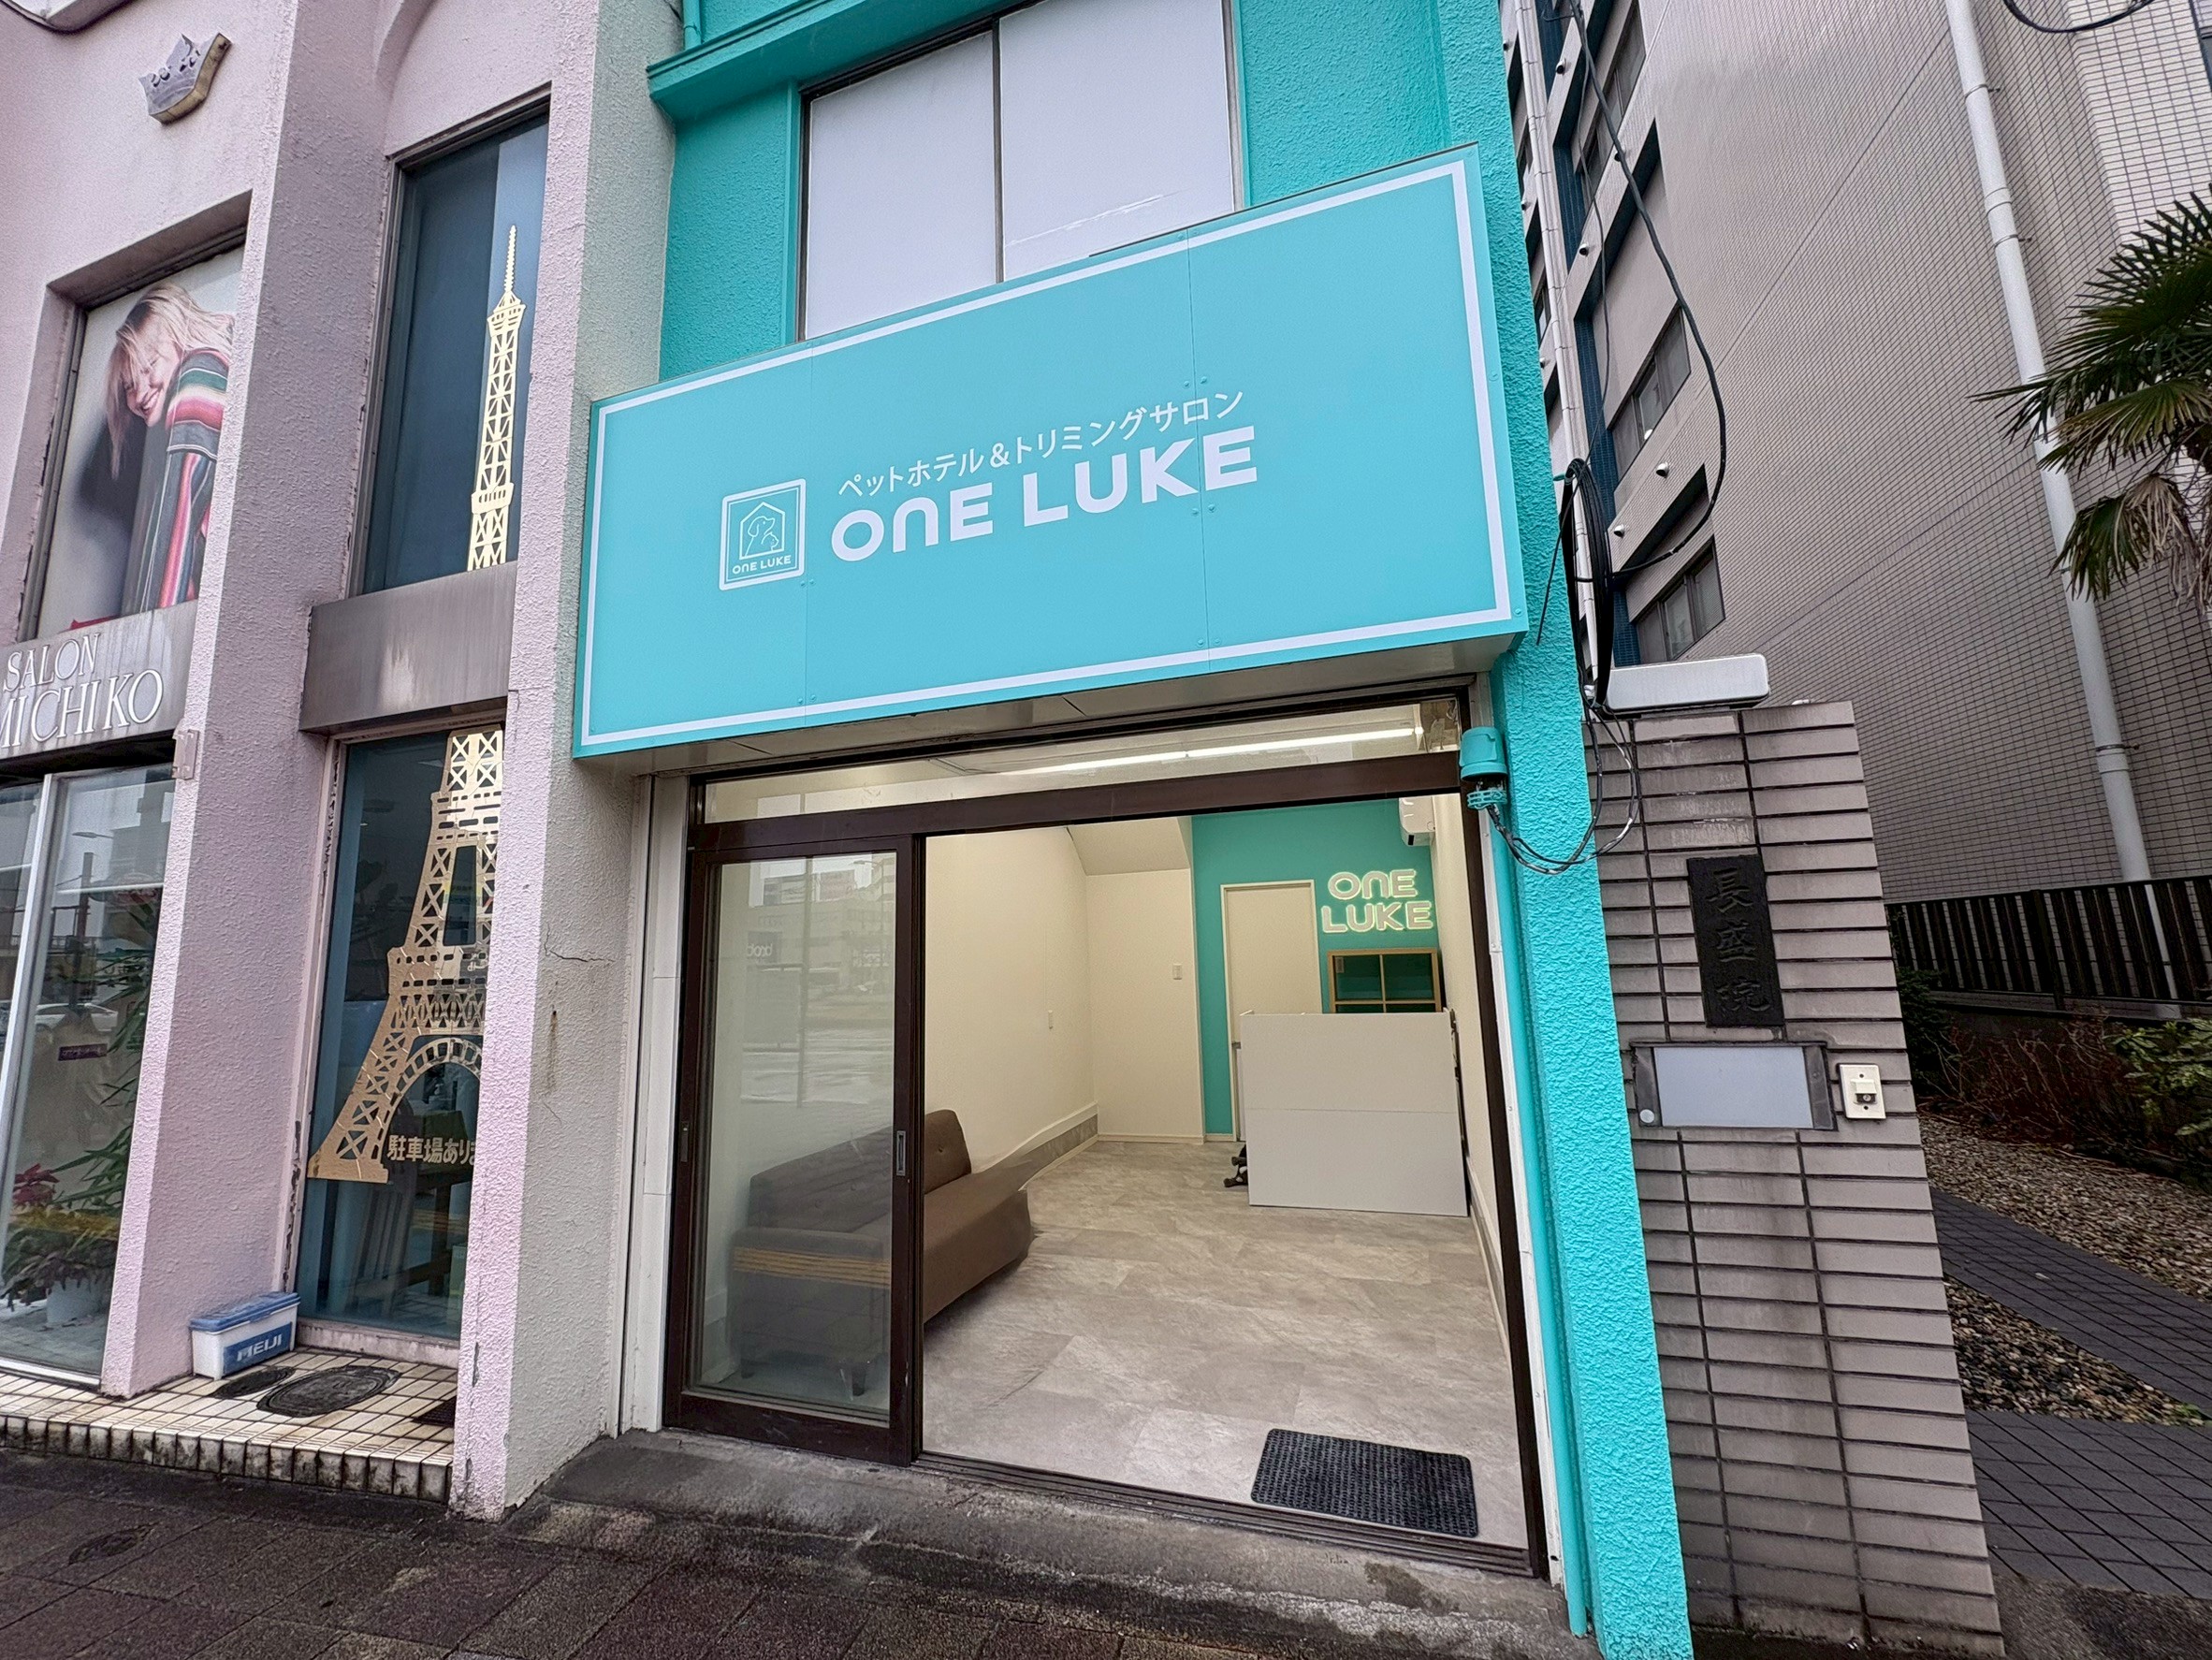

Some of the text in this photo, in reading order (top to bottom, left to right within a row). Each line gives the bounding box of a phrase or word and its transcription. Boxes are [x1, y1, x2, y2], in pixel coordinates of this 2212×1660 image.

[838, 390, 1244, 498] ペットホテル&トリミングサロン
[831, 425, 1258, 561] ONE LUKE
[732, 555, 792, 575] ONE LUKE
[2, 633, 101, 693] SALON
[1328, 868, 1419, 900] ONE
[1320, 900, 1433, 933] LUKE
[237, 1333, 283, 1362] MEIJI
